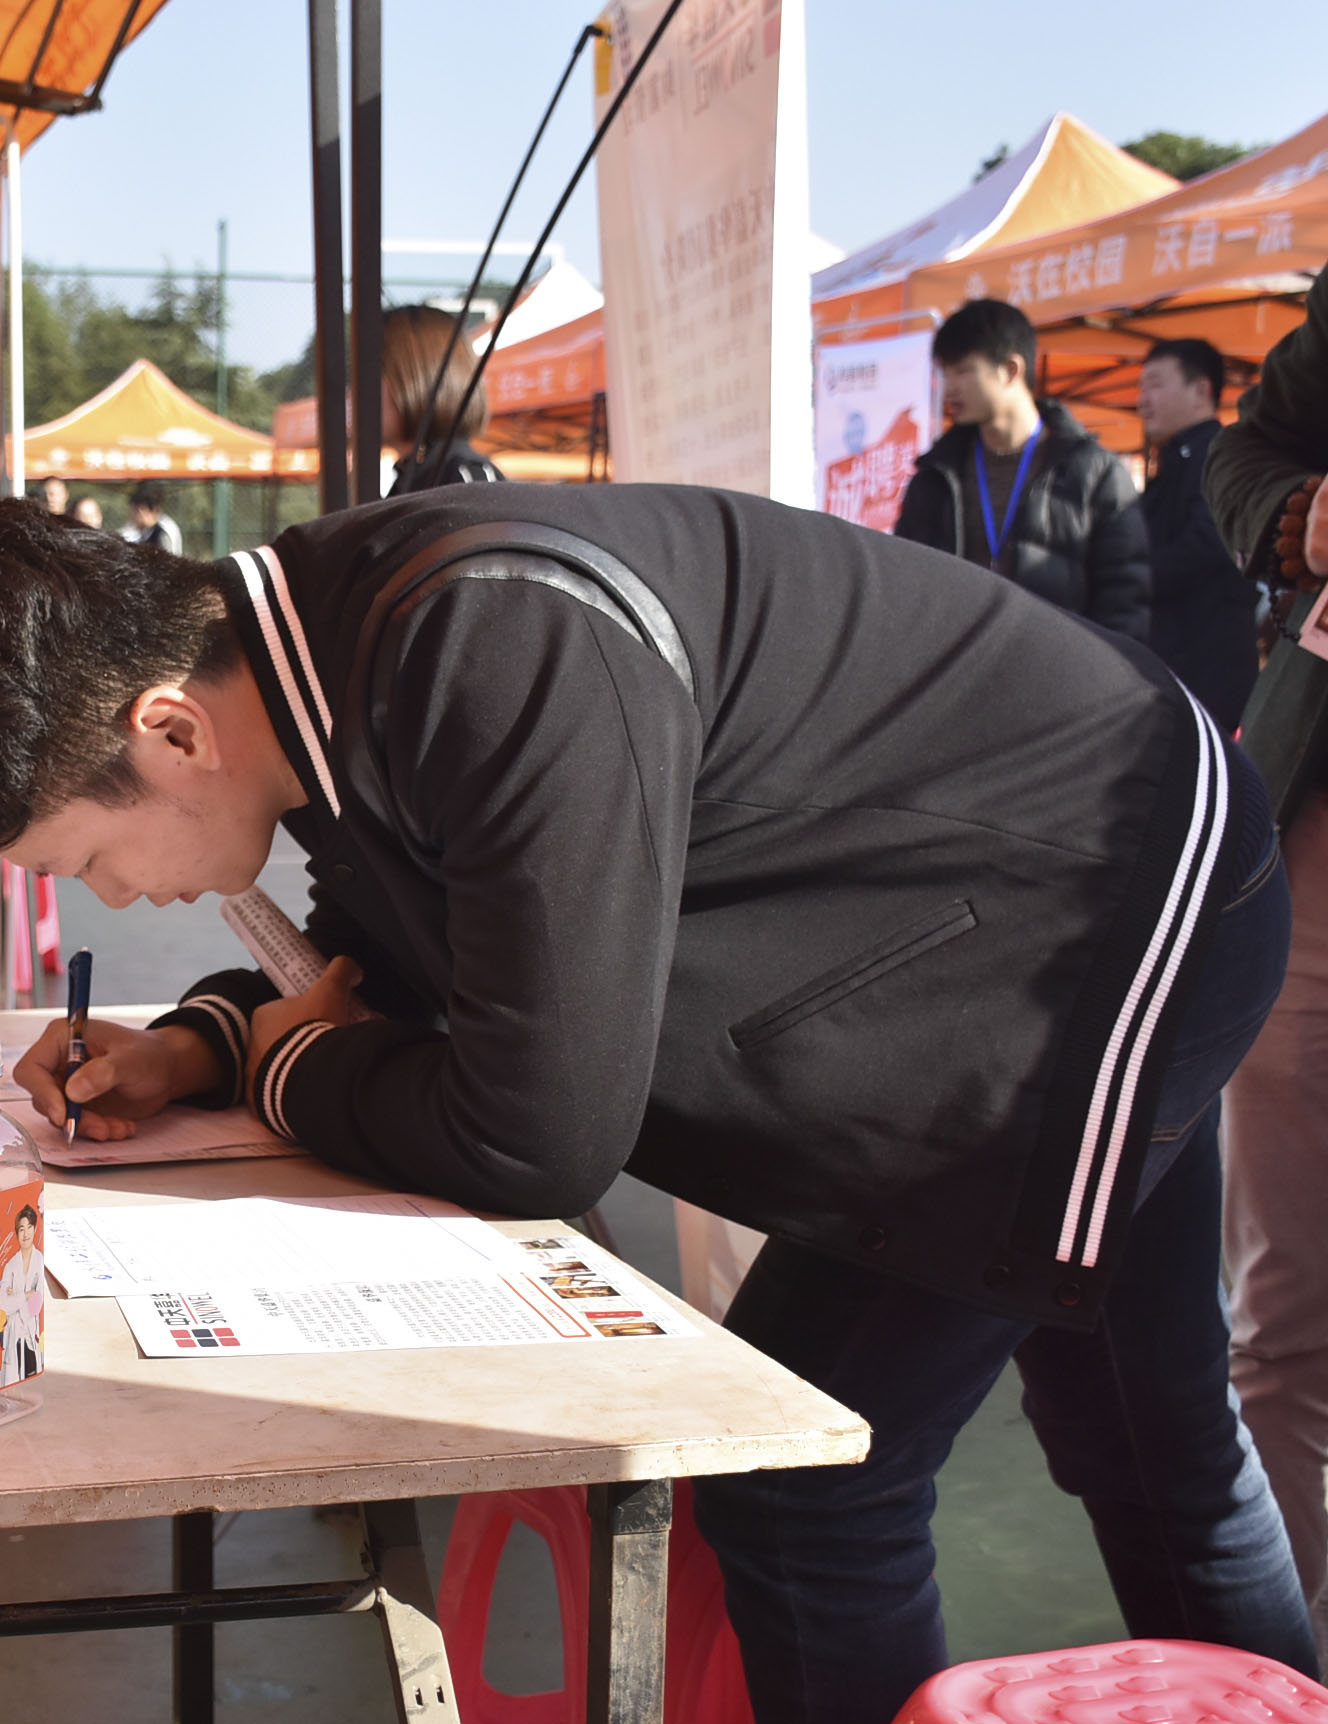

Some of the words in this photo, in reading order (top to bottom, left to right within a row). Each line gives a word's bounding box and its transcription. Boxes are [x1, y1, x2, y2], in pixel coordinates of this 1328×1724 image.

[1007, 234, 1128, 306] 沃在校园
[1152, 212, 1294, 277] 沃自一派
